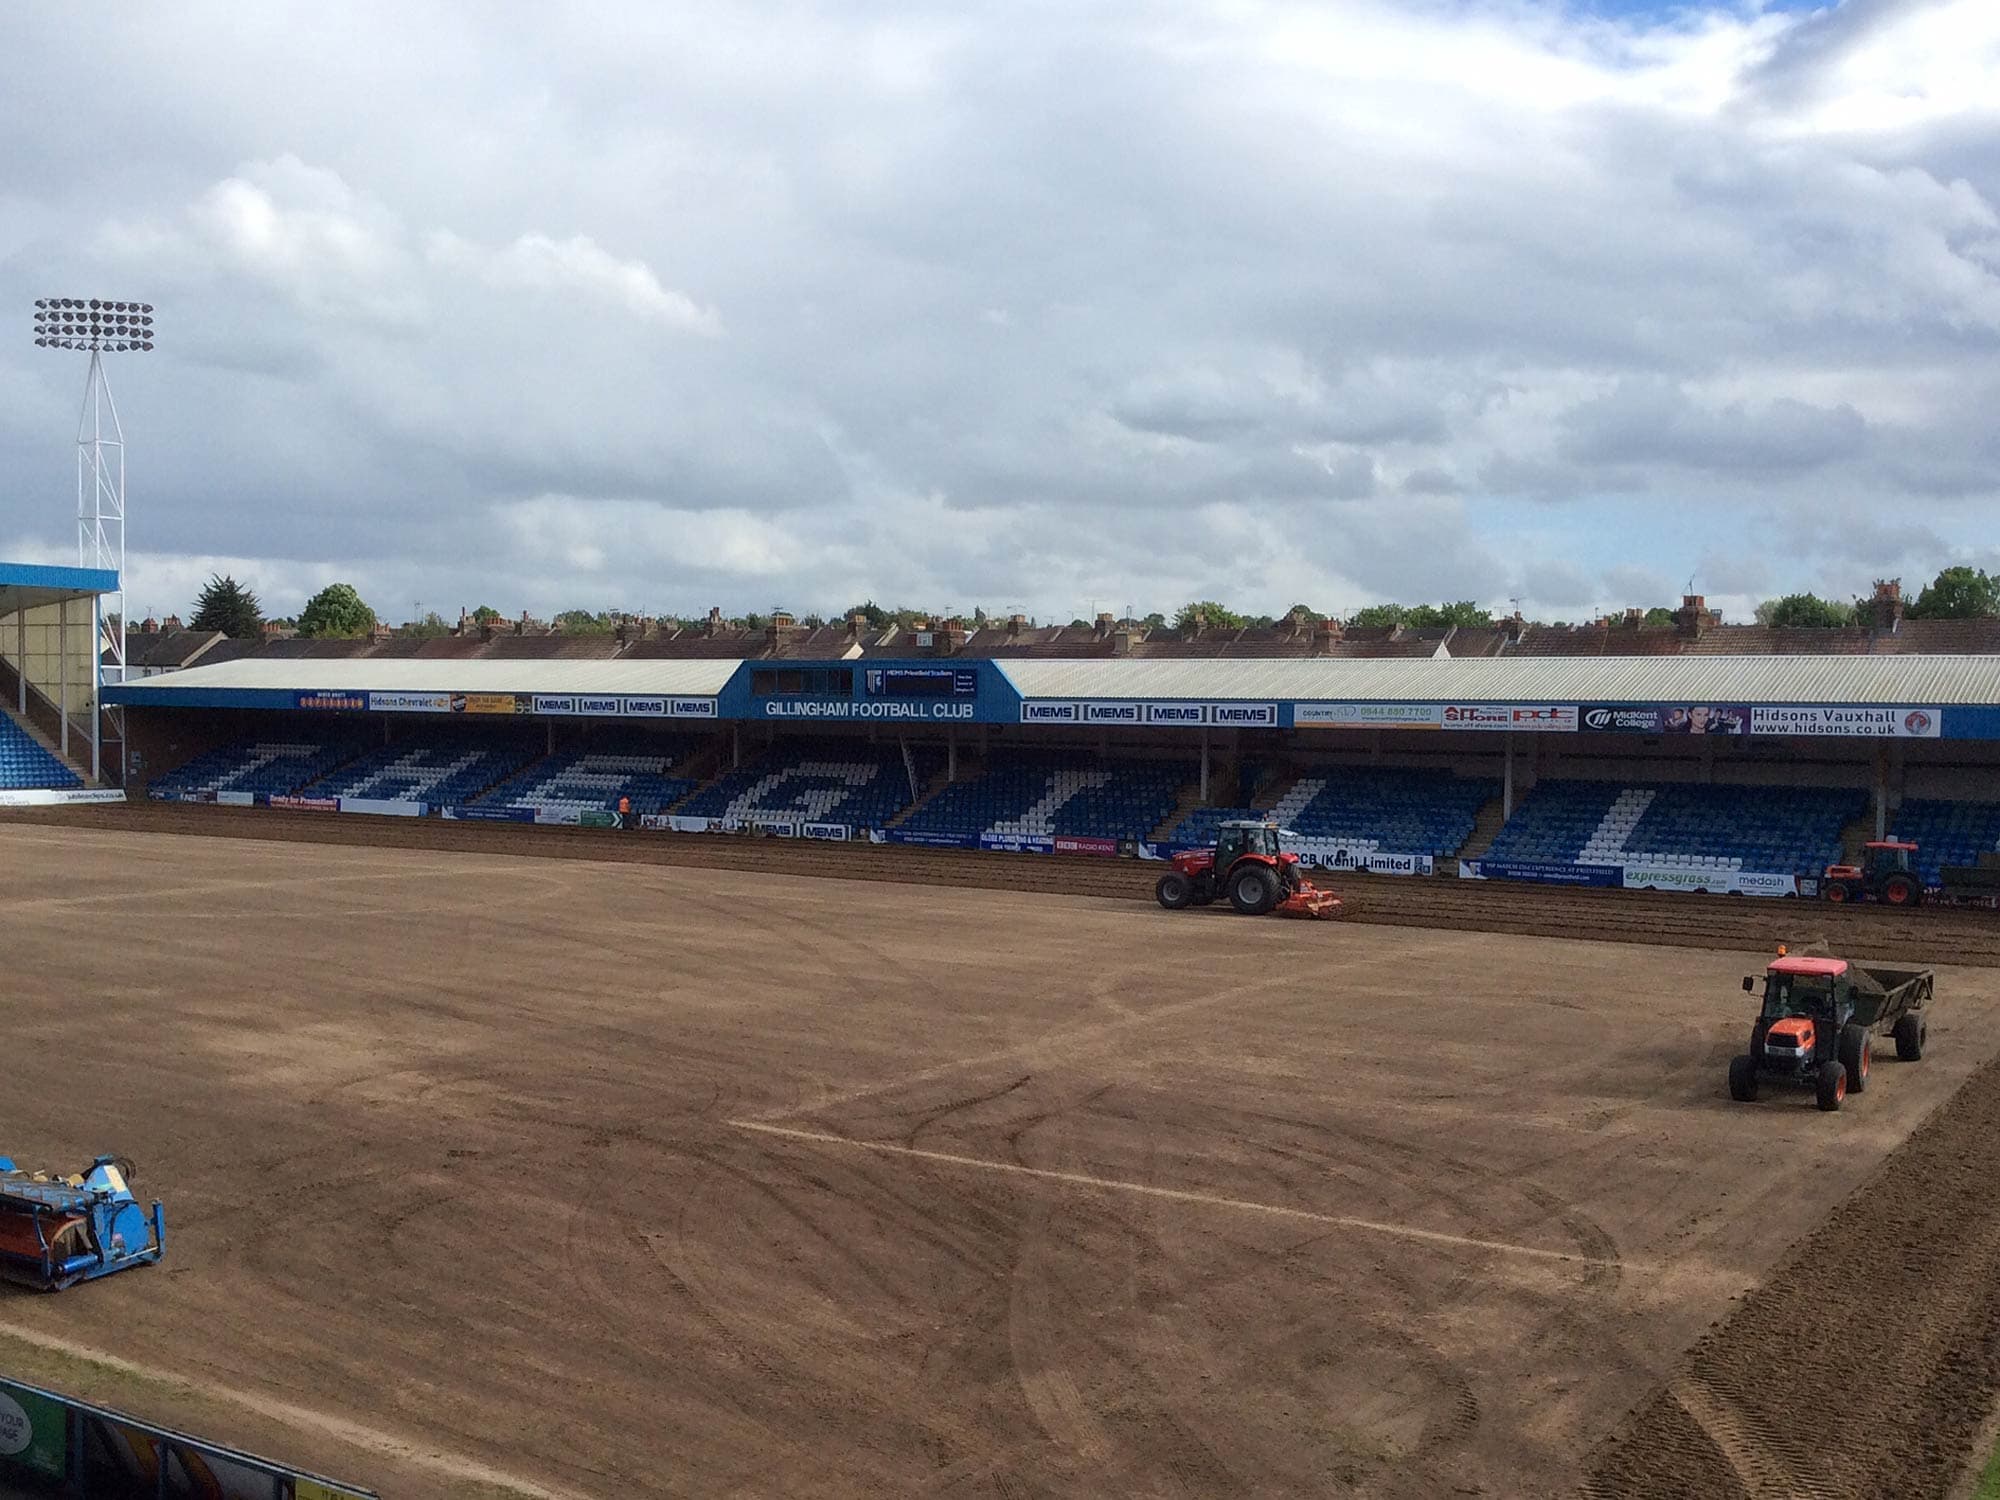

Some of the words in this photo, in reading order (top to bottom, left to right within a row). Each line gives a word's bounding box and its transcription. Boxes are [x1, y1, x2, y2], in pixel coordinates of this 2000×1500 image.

[399, 697, 432, 707] Chevrolet
[539, 700, 570, 710] MEMS
[584, 701, 615, 711] MEMS
[629, 702, 662, 712] MEMS
[676, 703, 710, 713] MEMS
[766, 702, 848, 716] GILLINGHAM
[852, 703, 928, 717] FOOTBALL
[933, 704, 973, 718] CLUB
[1029, 707, 1072, 717] MEMS
[1091, 708, 1134, 718] MEMS
[1153, 708, 1199, 719] MEMS
[1219, 709, 1267, 720] MEMS
[1612, 711, 1658, 721] MidKent
[1753, 710, 1817, 722] Hidsons
[1824, 710, 1896, 723] Vauxhall
[1614, 719, 1655, 730] College
[1753, 723, 1896, 734] www.hidsons.co.uk
[755, 823, 791, 835] MEMS
[806, 825, 843, 838] MEMS
[1057, 841, 1078, 850] BBC
[1098, 844, 1114, 852] KENT
[1321, 854, 1359, 867] (Kent)
[1363, 856, 1411, 870] Limited
